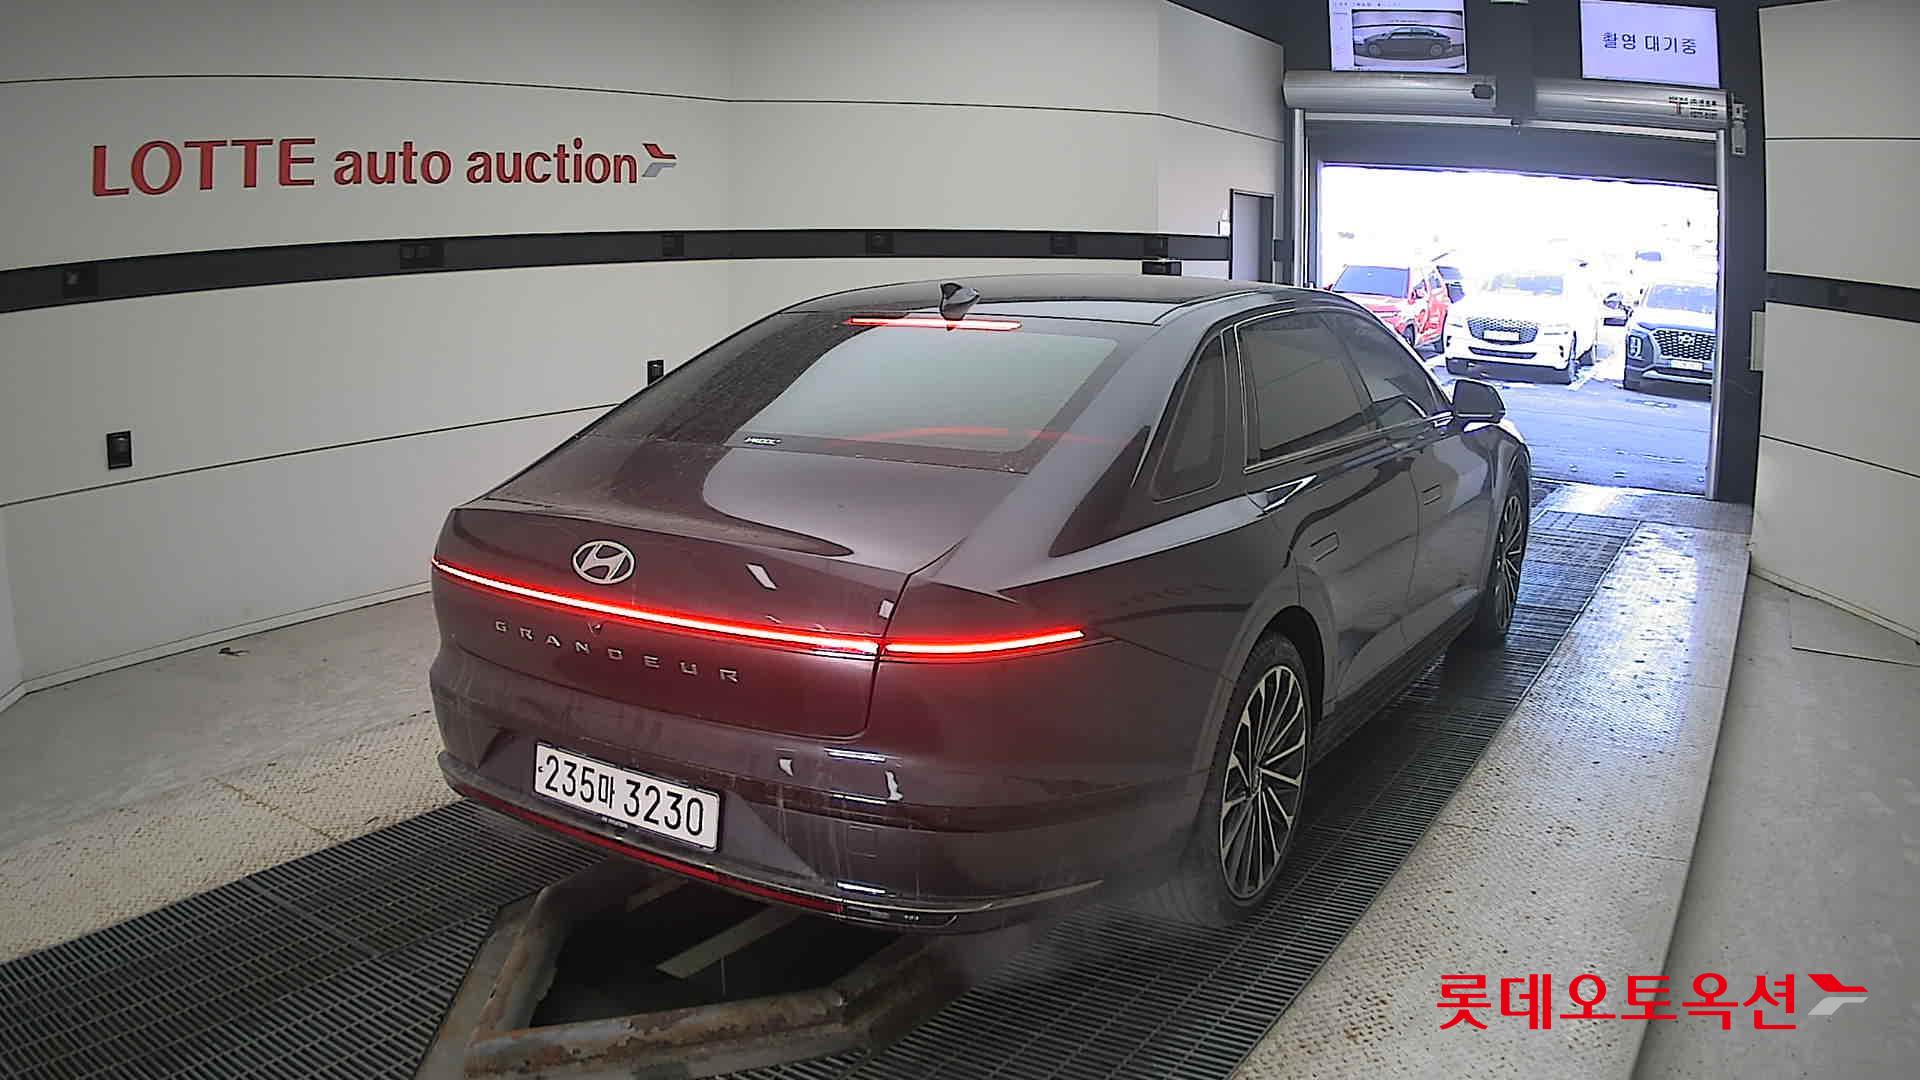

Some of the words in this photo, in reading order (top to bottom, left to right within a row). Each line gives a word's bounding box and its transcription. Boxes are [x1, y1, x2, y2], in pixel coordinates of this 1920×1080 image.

[1601, 32, 1636, 50] 촬영
[1645, 35, 1696, 55] 대기중
[93, 138, 315, 197] LOTTE
[334, 140, 452, 185] auto
[466, 138, 638, 184] auction
[495, 620, 739, 683] GRANDEUR
[545, 755, 615, 808] 235마
[624, 779, 703, 836] 3230
